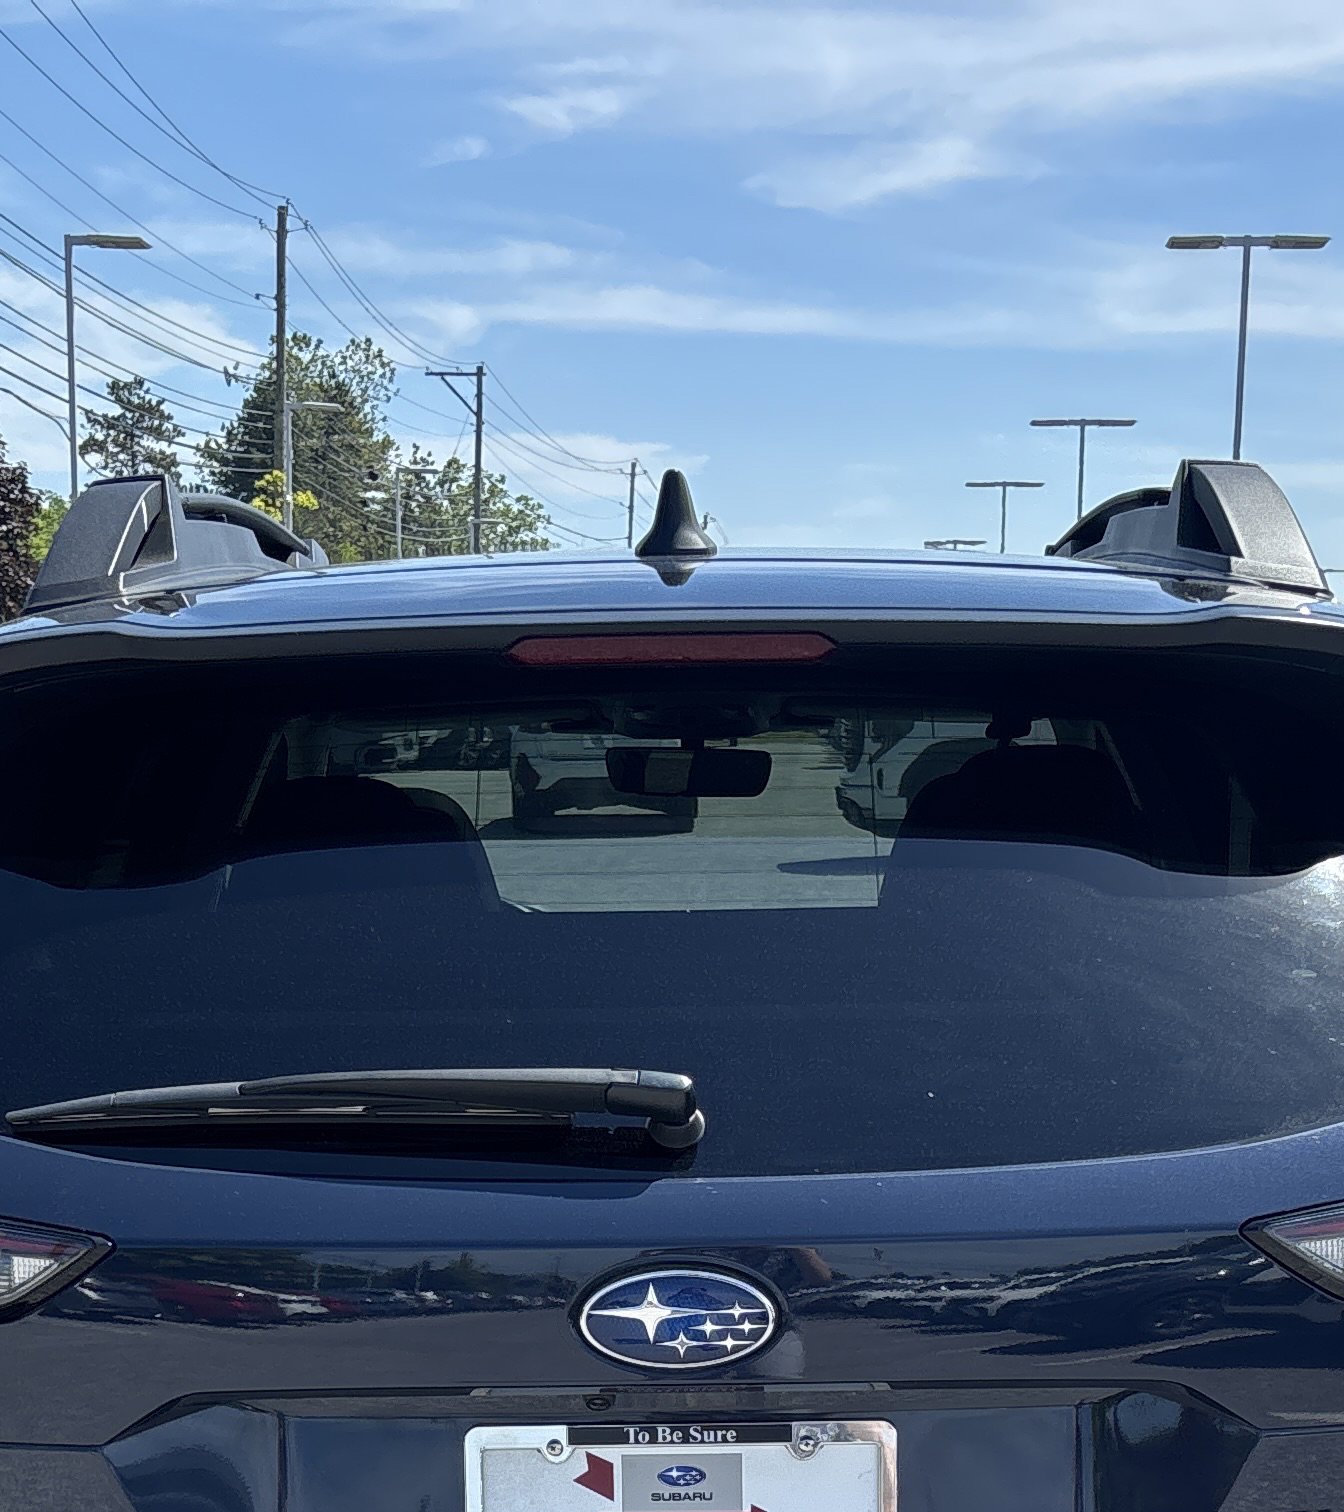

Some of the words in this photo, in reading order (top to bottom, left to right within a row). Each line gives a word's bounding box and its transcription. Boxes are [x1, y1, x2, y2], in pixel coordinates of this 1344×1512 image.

[624, 1427, 650, 1444] To
[656, 1426, 683, 1443] Be
[689, 1425, 737, 1443] Sure
[650, 1491, 713, 1502] SUBARU
